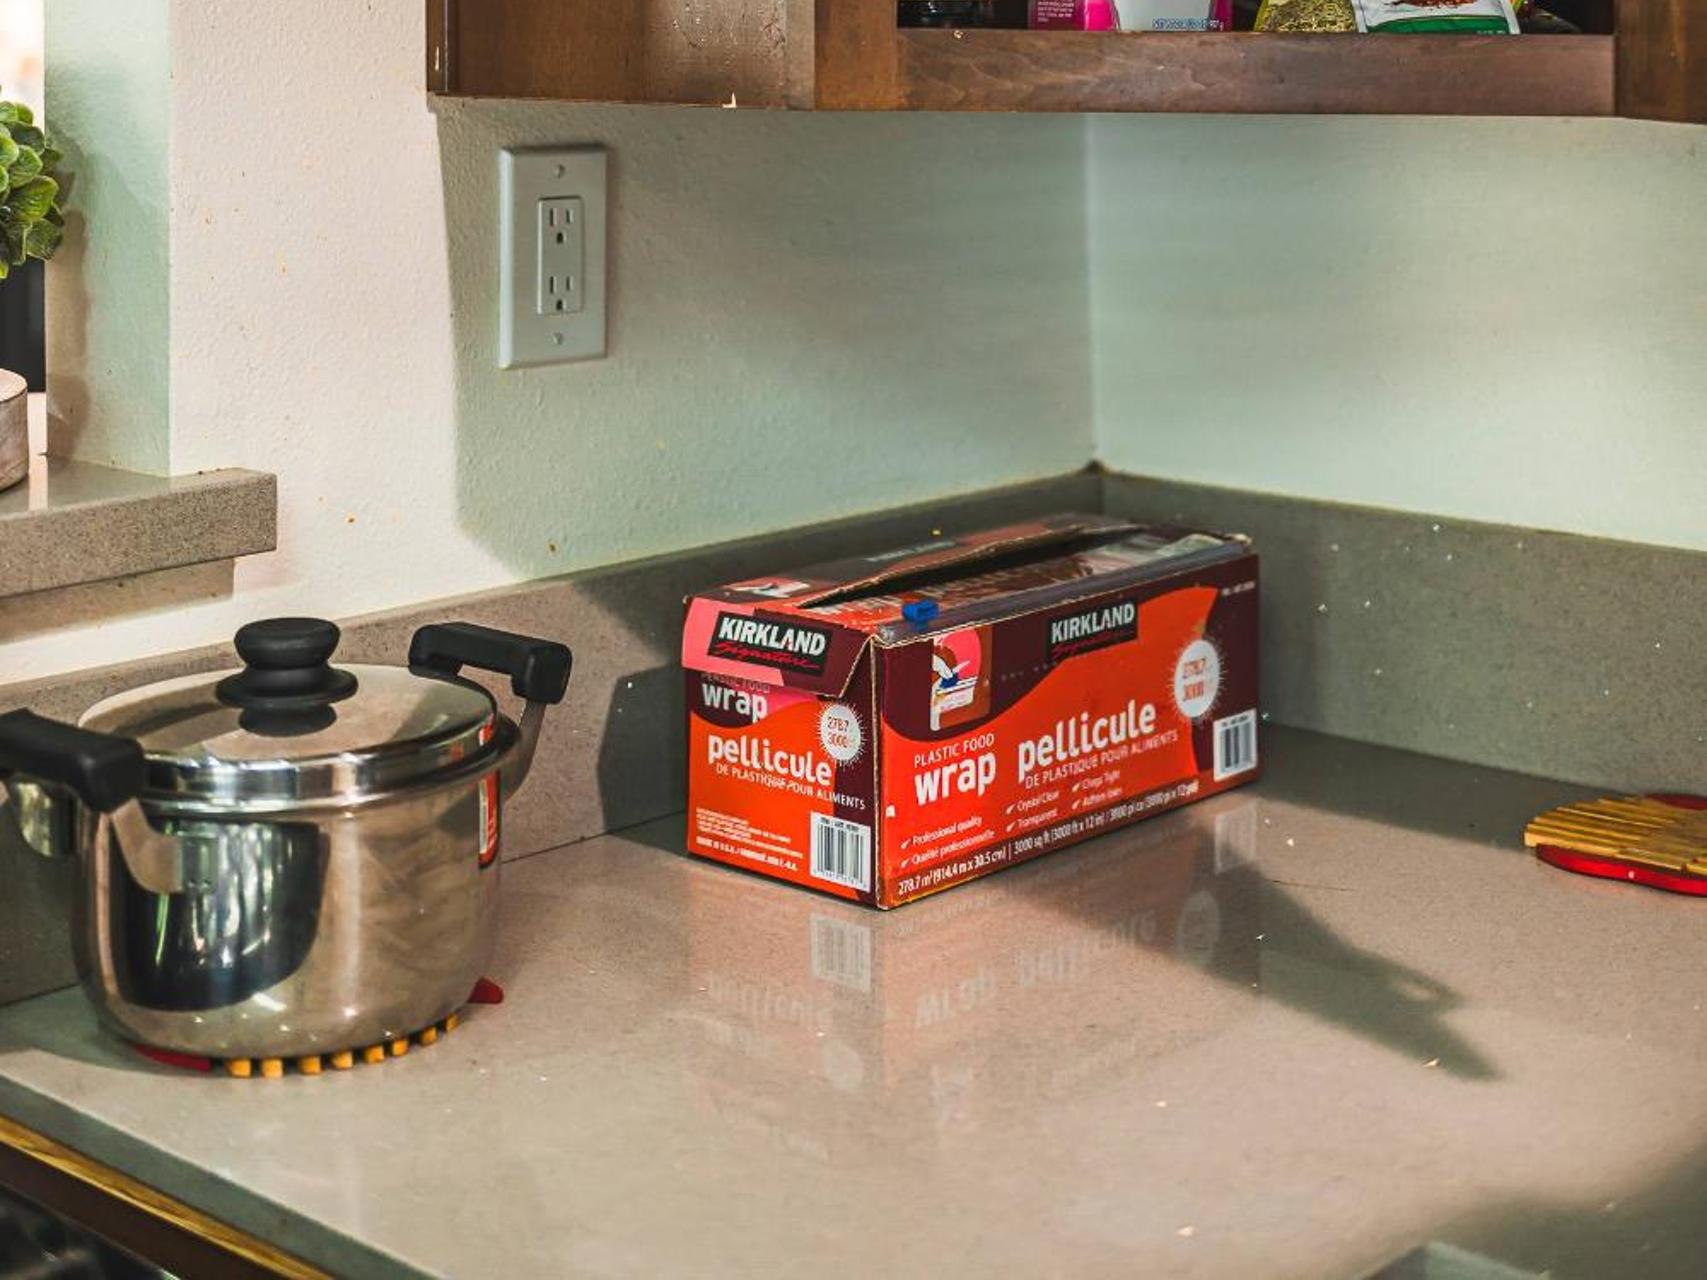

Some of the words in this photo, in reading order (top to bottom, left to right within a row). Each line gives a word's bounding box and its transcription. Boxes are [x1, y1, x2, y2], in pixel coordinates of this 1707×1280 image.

[717, 616, 827, 656] KIRKLAND
[1051, 603, 1135, 644] KIRKLAND
[702, 683, 768, 726] wrap
[708, 734, 832, 787] pellicule
[914, 742, 960, 769] PLASTIC
[963, 733, 995, 753] FOOD
[1018, 699, 1156, 784] pellicule
[914, 752, 996, 806] wrap
[1025, 773, 1040, 789] DE
